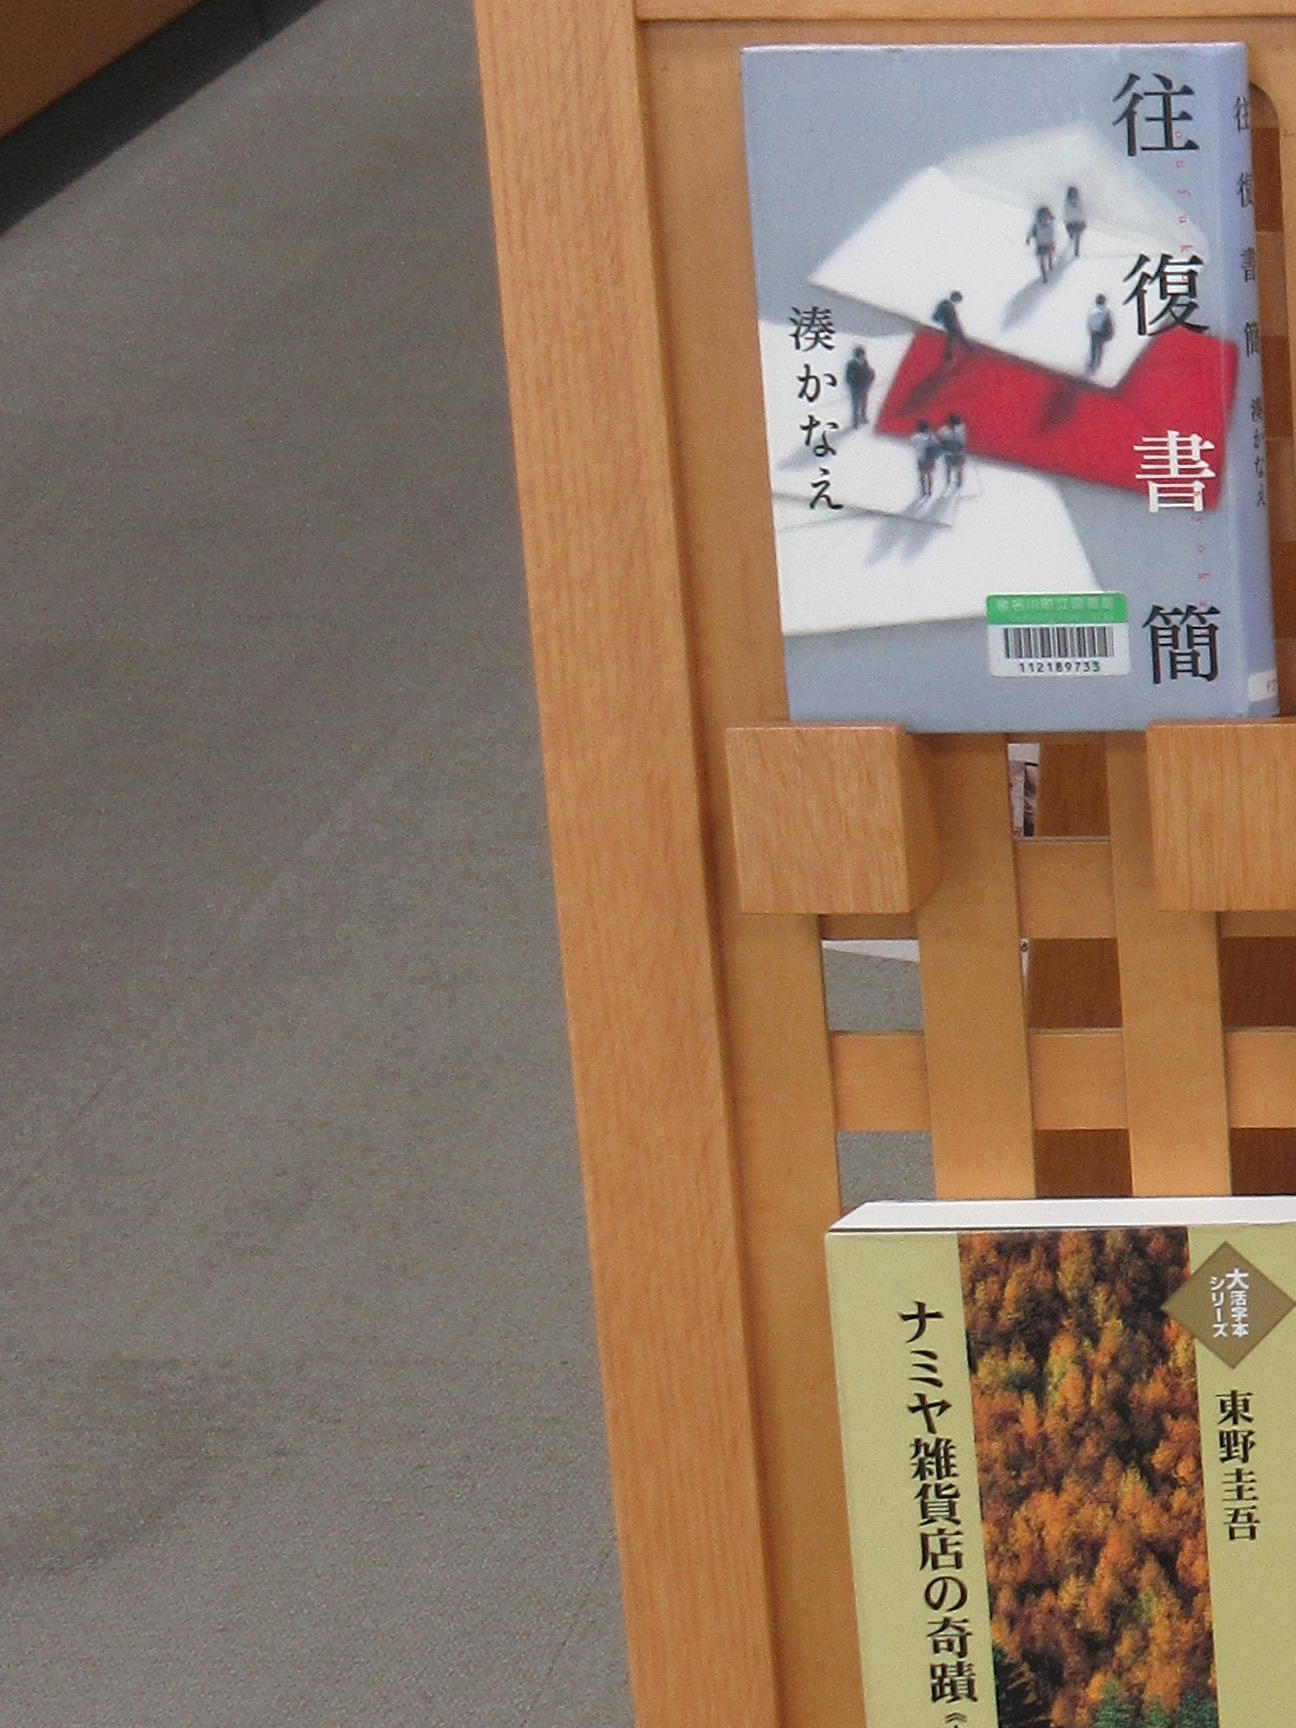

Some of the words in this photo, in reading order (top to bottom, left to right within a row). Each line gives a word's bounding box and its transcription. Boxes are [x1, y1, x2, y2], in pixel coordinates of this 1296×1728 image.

[789, 306, 844, 510] 湊かなえ
[1112, 72, 1221, 686] 往復書簡
[1019, 661, 1101, 673] 112189733
[1209, 1275, 1230, 1338] シリーズ
[1226, 1268, 1250, 1338] 大活字本
[1215, 1389, 1261, 1543] 東野圭吾
